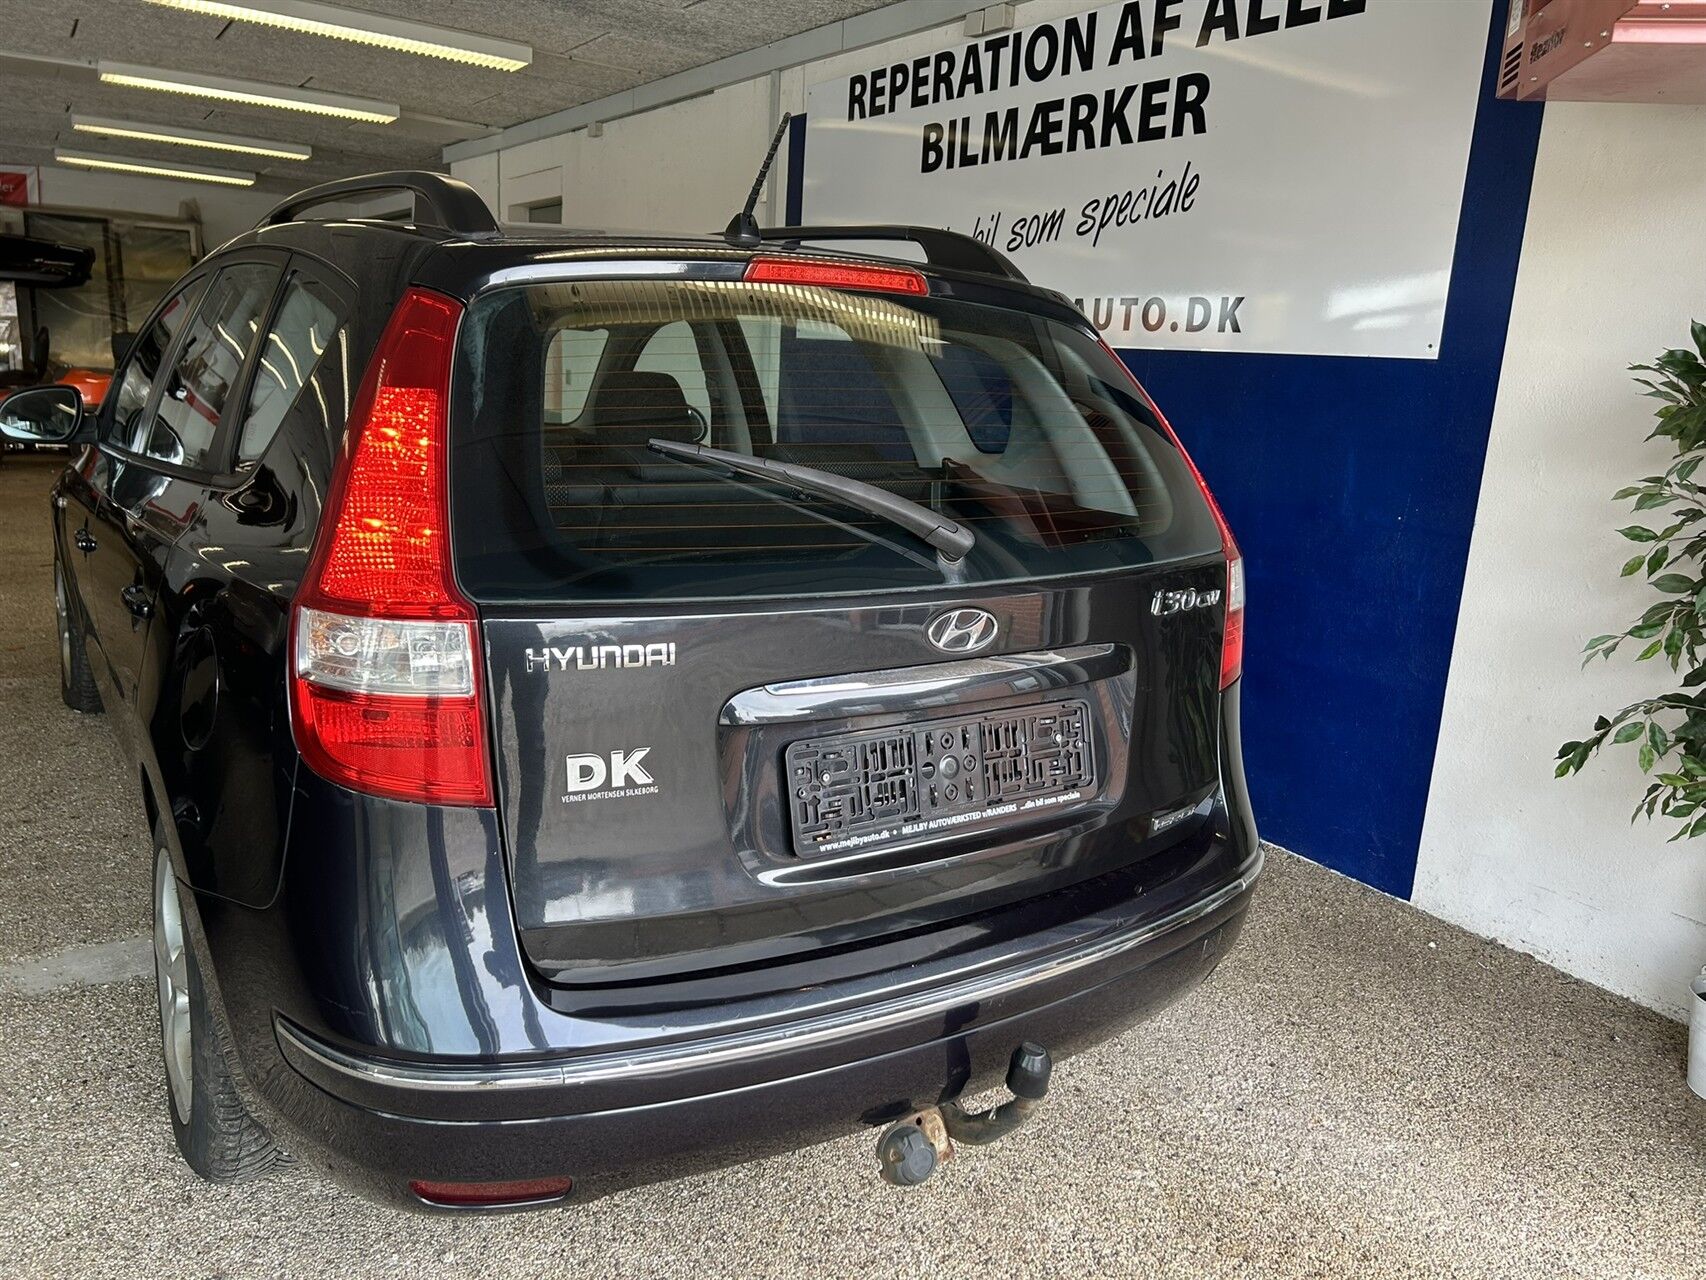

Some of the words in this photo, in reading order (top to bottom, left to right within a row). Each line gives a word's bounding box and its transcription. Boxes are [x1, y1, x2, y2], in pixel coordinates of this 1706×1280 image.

[847, 11, 1098, 122] REPERATION
[1108, 0, 1184, 66] AF
[1195, 0, 1367, 48] AL
[921, 72, 1211, 173] BILMÆRKER
[1006, 208, 1067, 252] som
[1076, 160, 1200, 248] speciale
[525, 642, 676, 673] HYUNDAI
[566, 746, 655, 793] DK
[561, 793, 587, 804] VERNER
[587, 789, 625, 801] MORTENSEN
[625, 785, 659, 797] SILKEBORG
[819, 829, 891, 852] www.mejlbyauto.dk
[901, 818, 928, 835] MEJLBY
